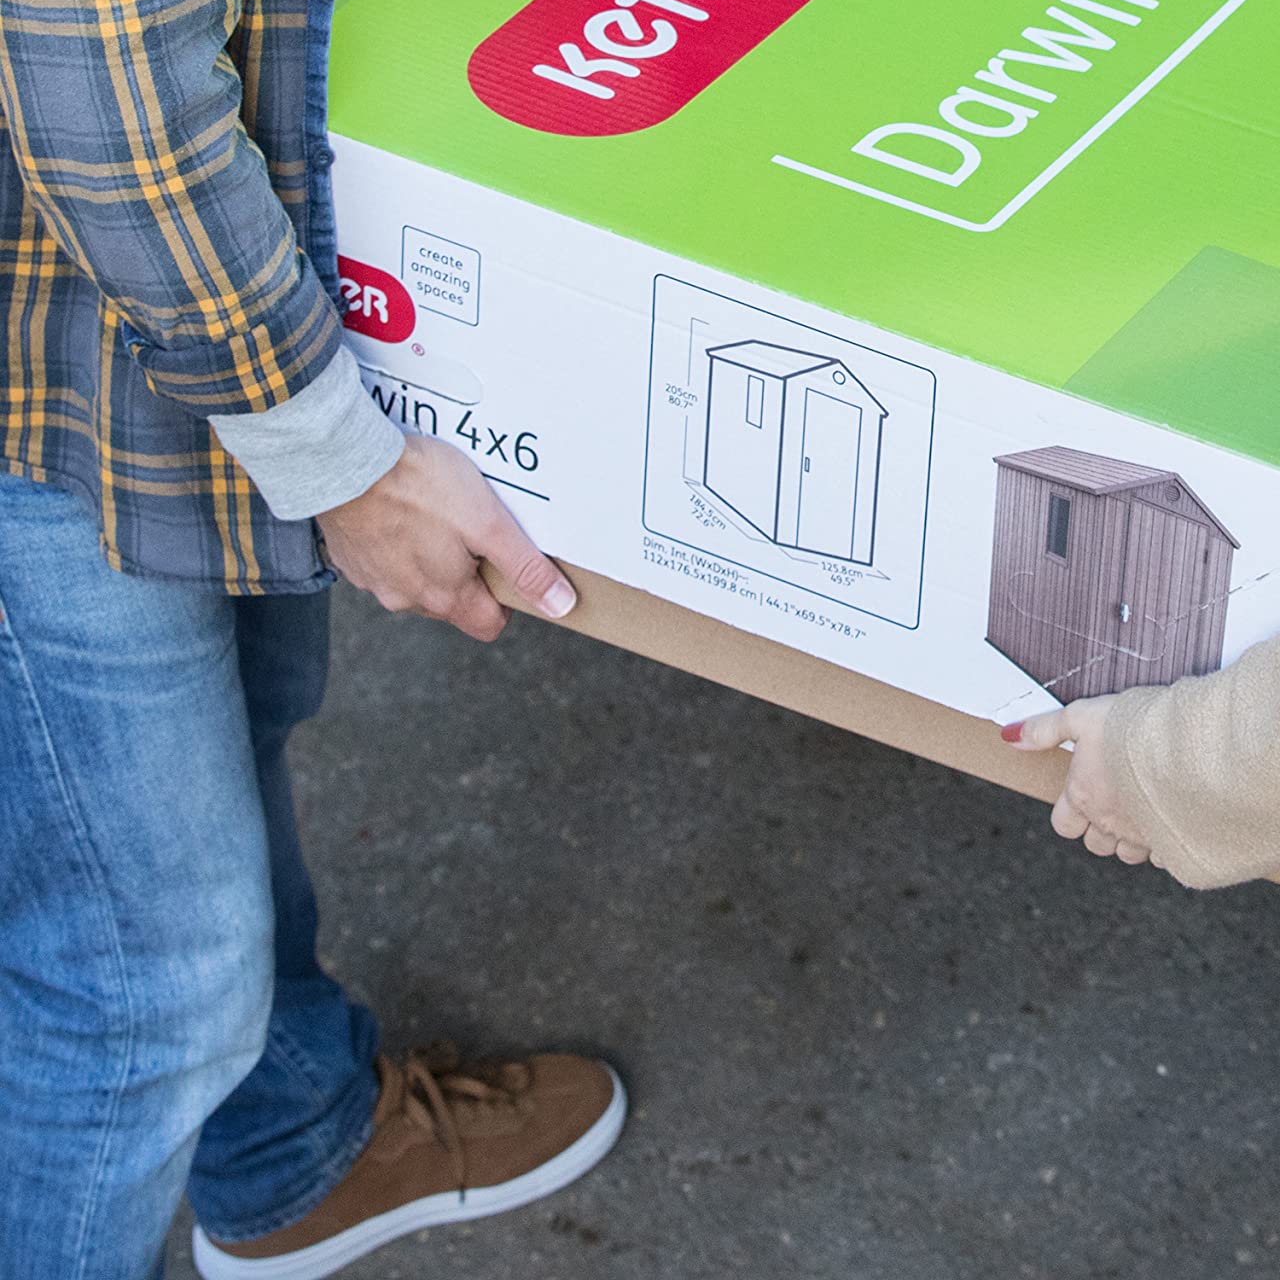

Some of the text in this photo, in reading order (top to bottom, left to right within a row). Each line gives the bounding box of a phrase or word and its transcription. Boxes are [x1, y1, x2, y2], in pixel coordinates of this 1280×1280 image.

[418, 246, 464, 270] create
[410, 261, 471, 294] amazing
[416, 280, 464, 306] spaces
[665, 382, 698, 403] 205cm
[371, 384, 540, 472] win 4x6
[643, 536, 668, 554] Dim.
[821, 561, 864, 578] 125.8cm
[643, 549, 737, 593] 112x176.5x199.8
[739, 586, 757, 600] cm
[766, 596, 867, 640] 44.1"x69.5"x78.7"
